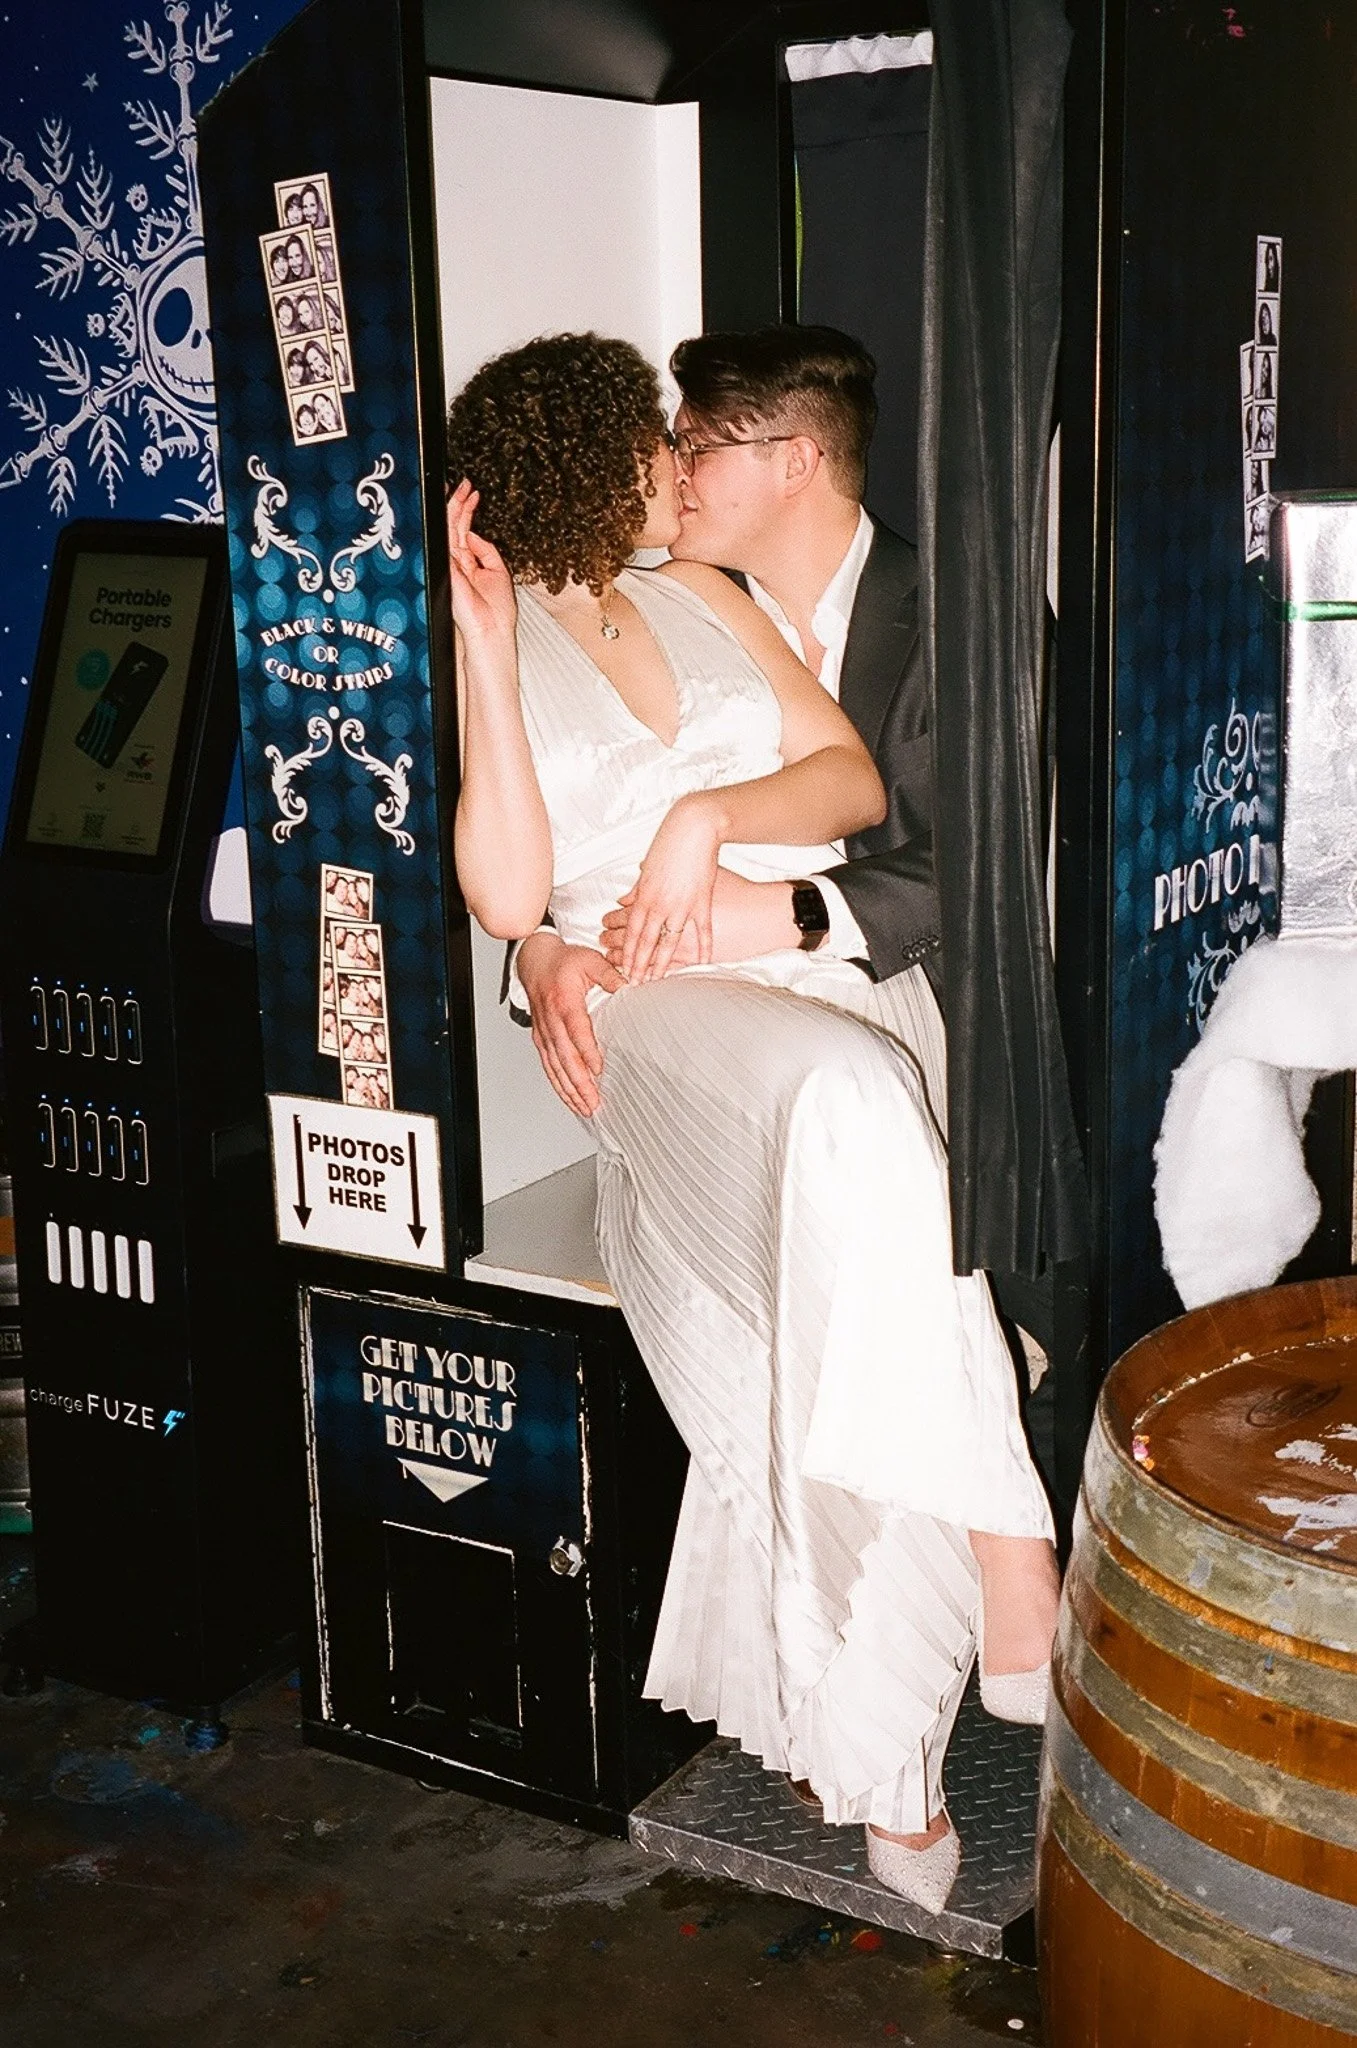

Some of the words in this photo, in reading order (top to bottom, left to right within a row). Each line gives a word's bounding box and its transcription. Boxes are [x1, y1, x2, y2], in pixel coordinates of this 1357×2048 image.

[96, 587, 172, 607] Portable
[89, 608, 172, 632] Chargers
[260, 617, 317, 647] BLACK
[322, 617, 336, 634] &
[340, 619, 398, 653] WHITE
[313, 646, 339, 664] OR
[265, 657, 327, 691] COLOR
[332, 661, 394, 691] STRIPS
[1153, 843, 1244, 932] PHOTO
[308, 1132, 405, 1166] PHOTOS
[328, 1163, 385, 1187] DROP
[329, 1186, 386, 1212] HERE
[360, 1335, 418, 1373] GET
[425, 1346, 517, 1398] YOUR
[362, 1372, 517, 1432] PICTURES
[385, 1414, 497, 1468] BELOW
